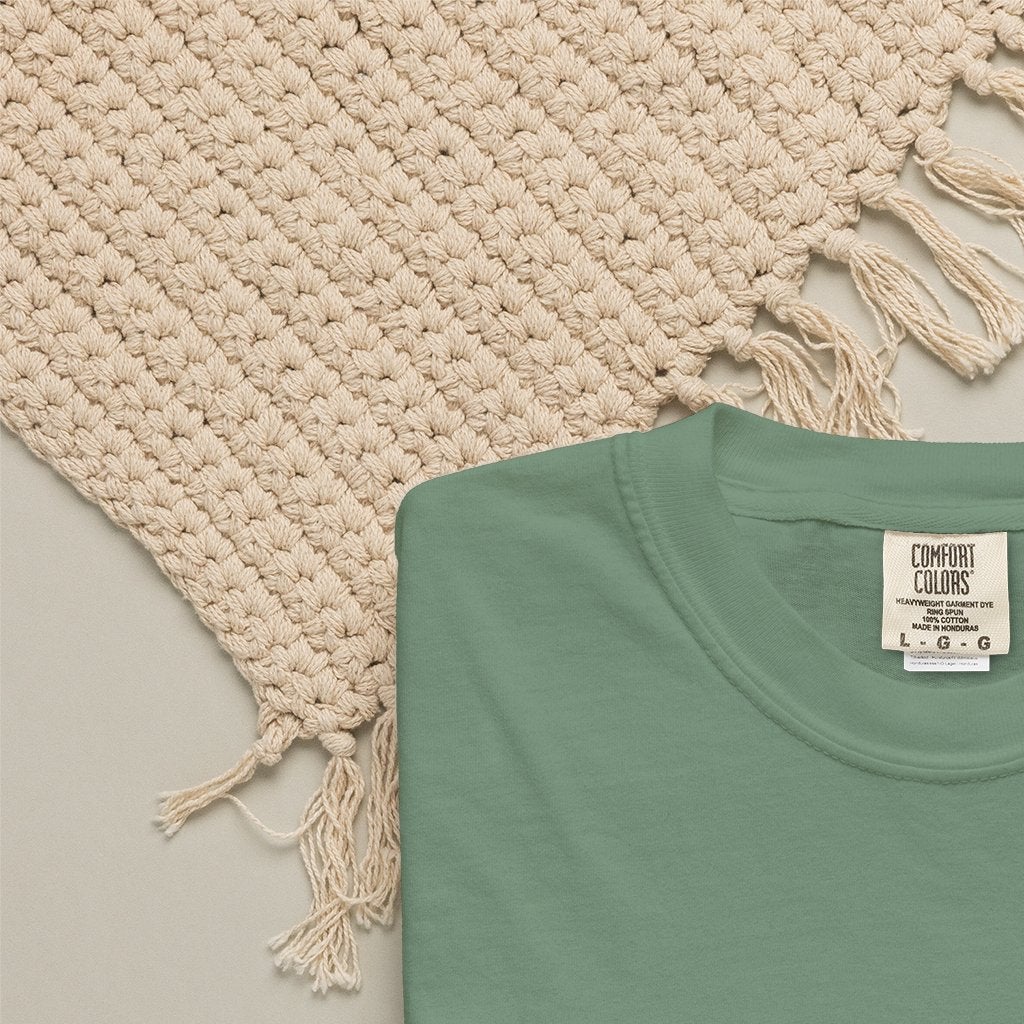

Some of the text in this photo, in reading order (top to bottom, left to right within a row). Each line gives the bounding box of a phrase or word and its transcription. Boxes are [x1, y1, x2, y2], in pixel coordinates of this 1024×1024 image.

[911, 543, 976, 568] COMFORT
[895, 598, 944, 607] HEAVYWEIGHT
[980, 601, 994, 609] DYE
[912, 623, 979, 632] MADE IN HONDURAS
[900, 632, 910, 647] L
[937, 635, 950, 650] G
[977, 636, 991, 650] G
